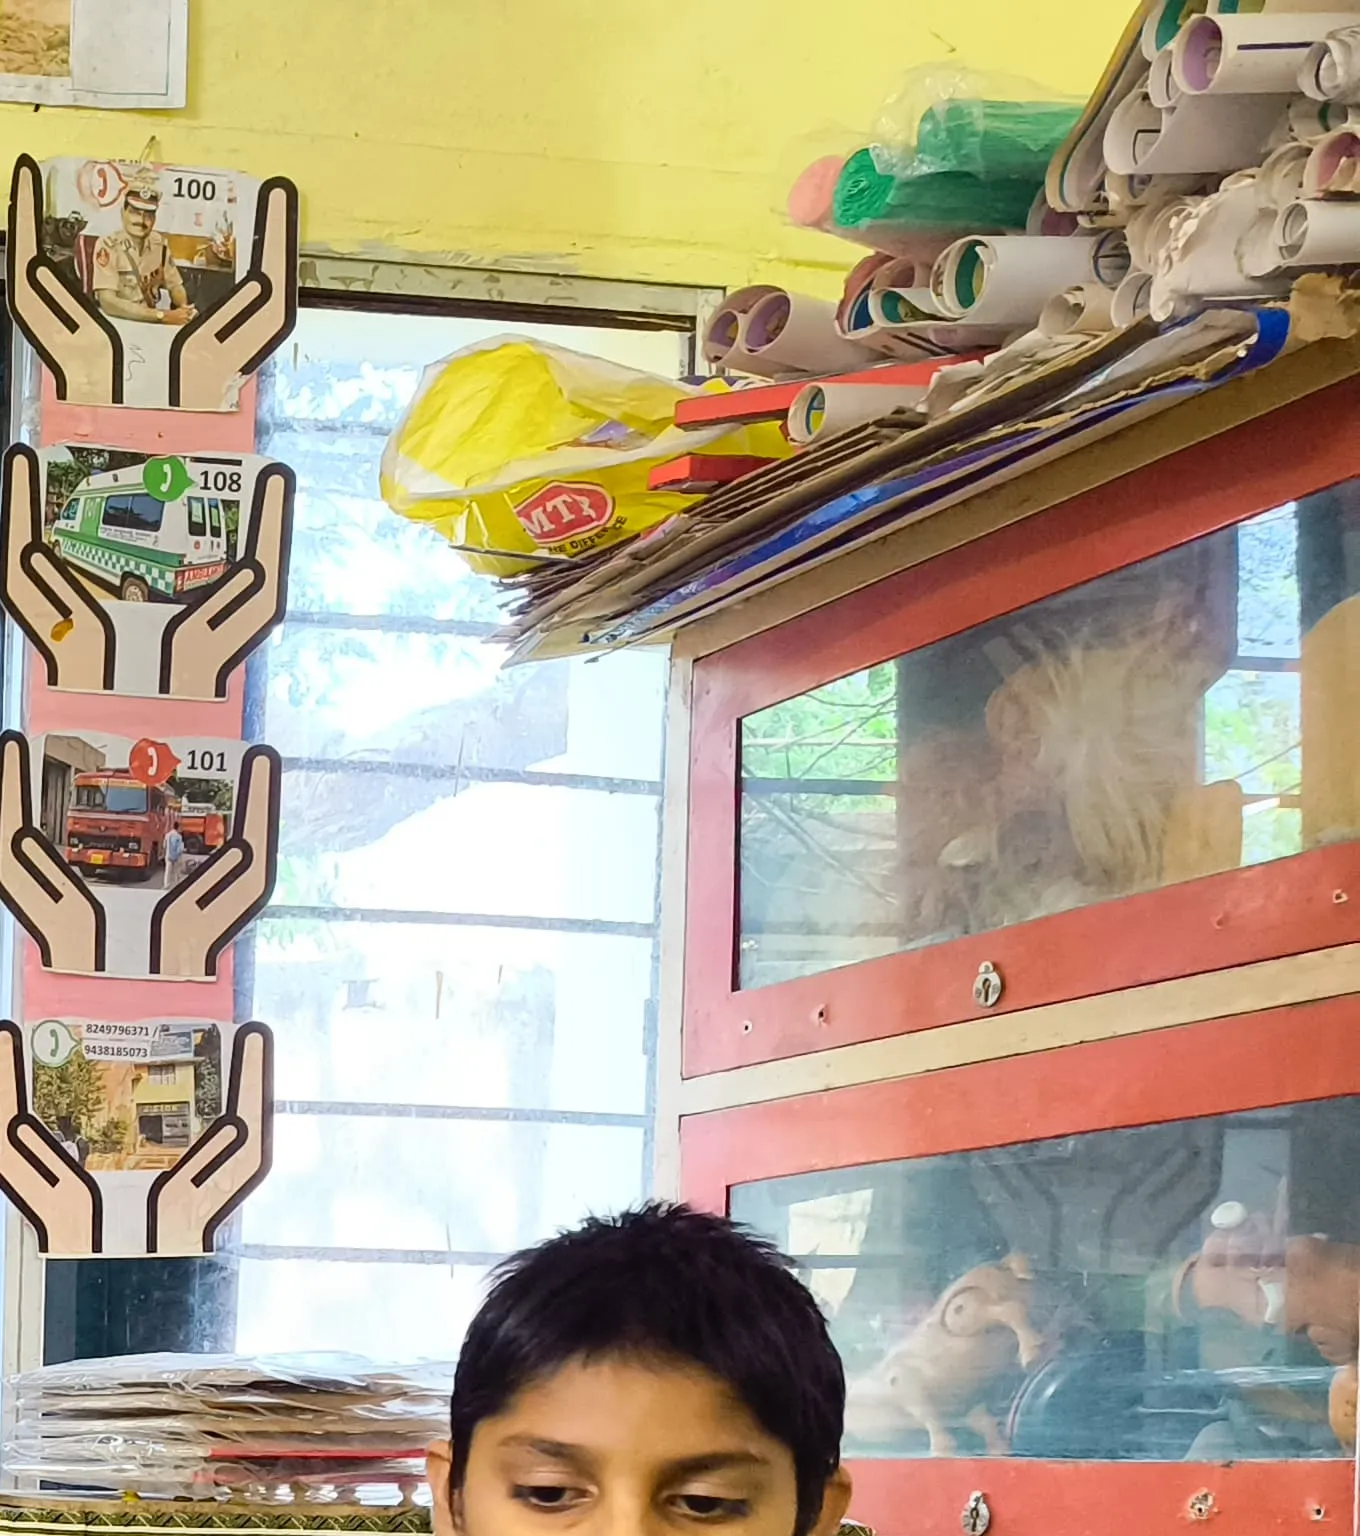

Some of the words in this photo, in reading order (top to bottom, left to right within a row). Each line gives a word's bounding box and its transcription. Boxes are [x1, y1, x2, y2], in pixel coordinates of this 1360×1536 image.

[172, 176, 216, 201] 100
[199, 470, 243, 493] 108
[186, 749, 228, 773] 101
